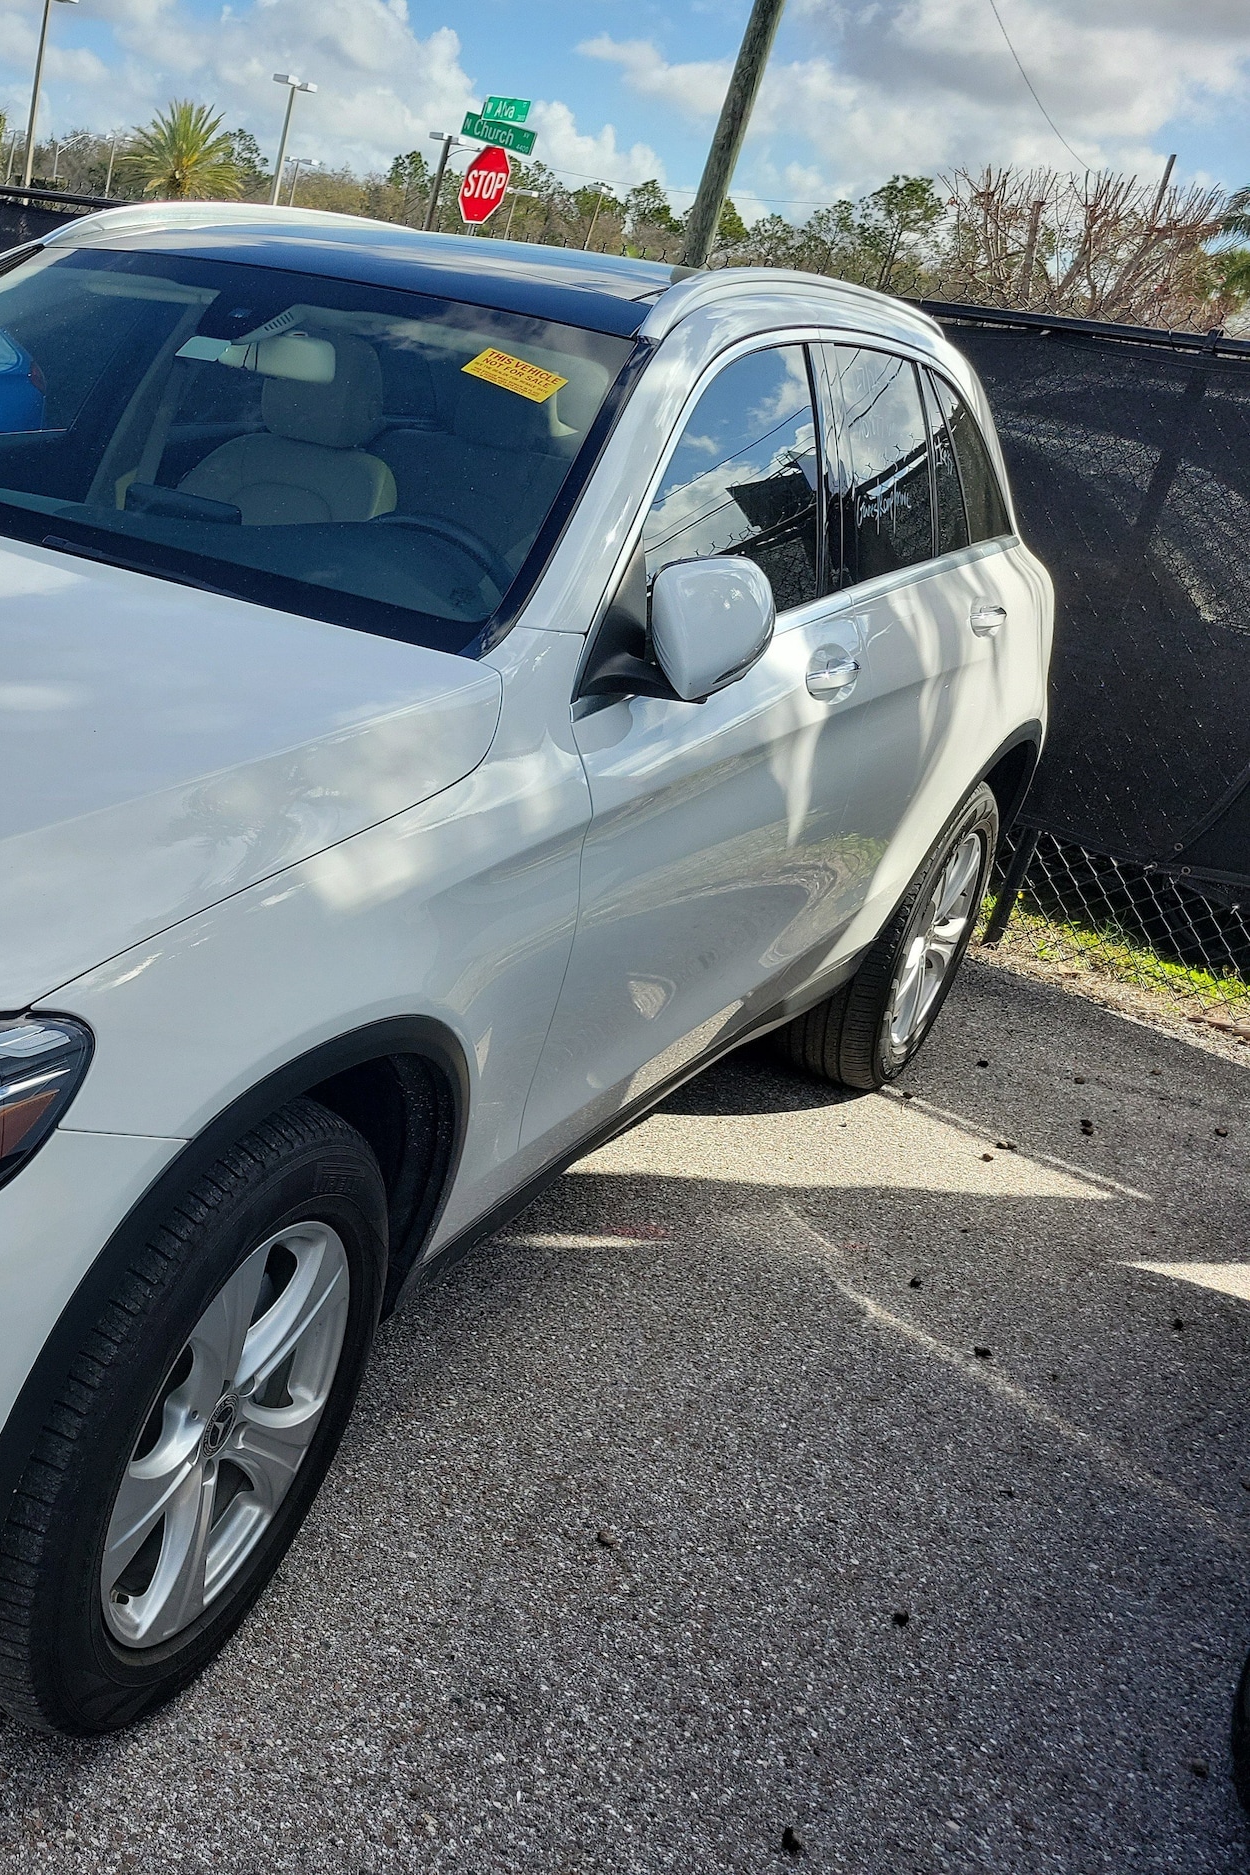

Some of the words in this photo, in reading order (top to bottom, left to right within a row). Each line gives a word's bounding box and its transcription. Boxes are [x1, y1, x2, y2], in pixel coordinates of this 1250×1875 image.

[494, 100, 515, 118] Alva
[463, 118, 471, 130] N
[473, 119, 514, 146] Church
[516, 144, 529, 153] 4400
[463, 169, 507, 200] STOP
[482, 357, 503, 368] NOT
[503, 366, 525, 377] FOR
[524, 375, 551, 388] SALE
[488, 350, 514, 364] THIS
[514, 361, 562, 385] VEHICLE
